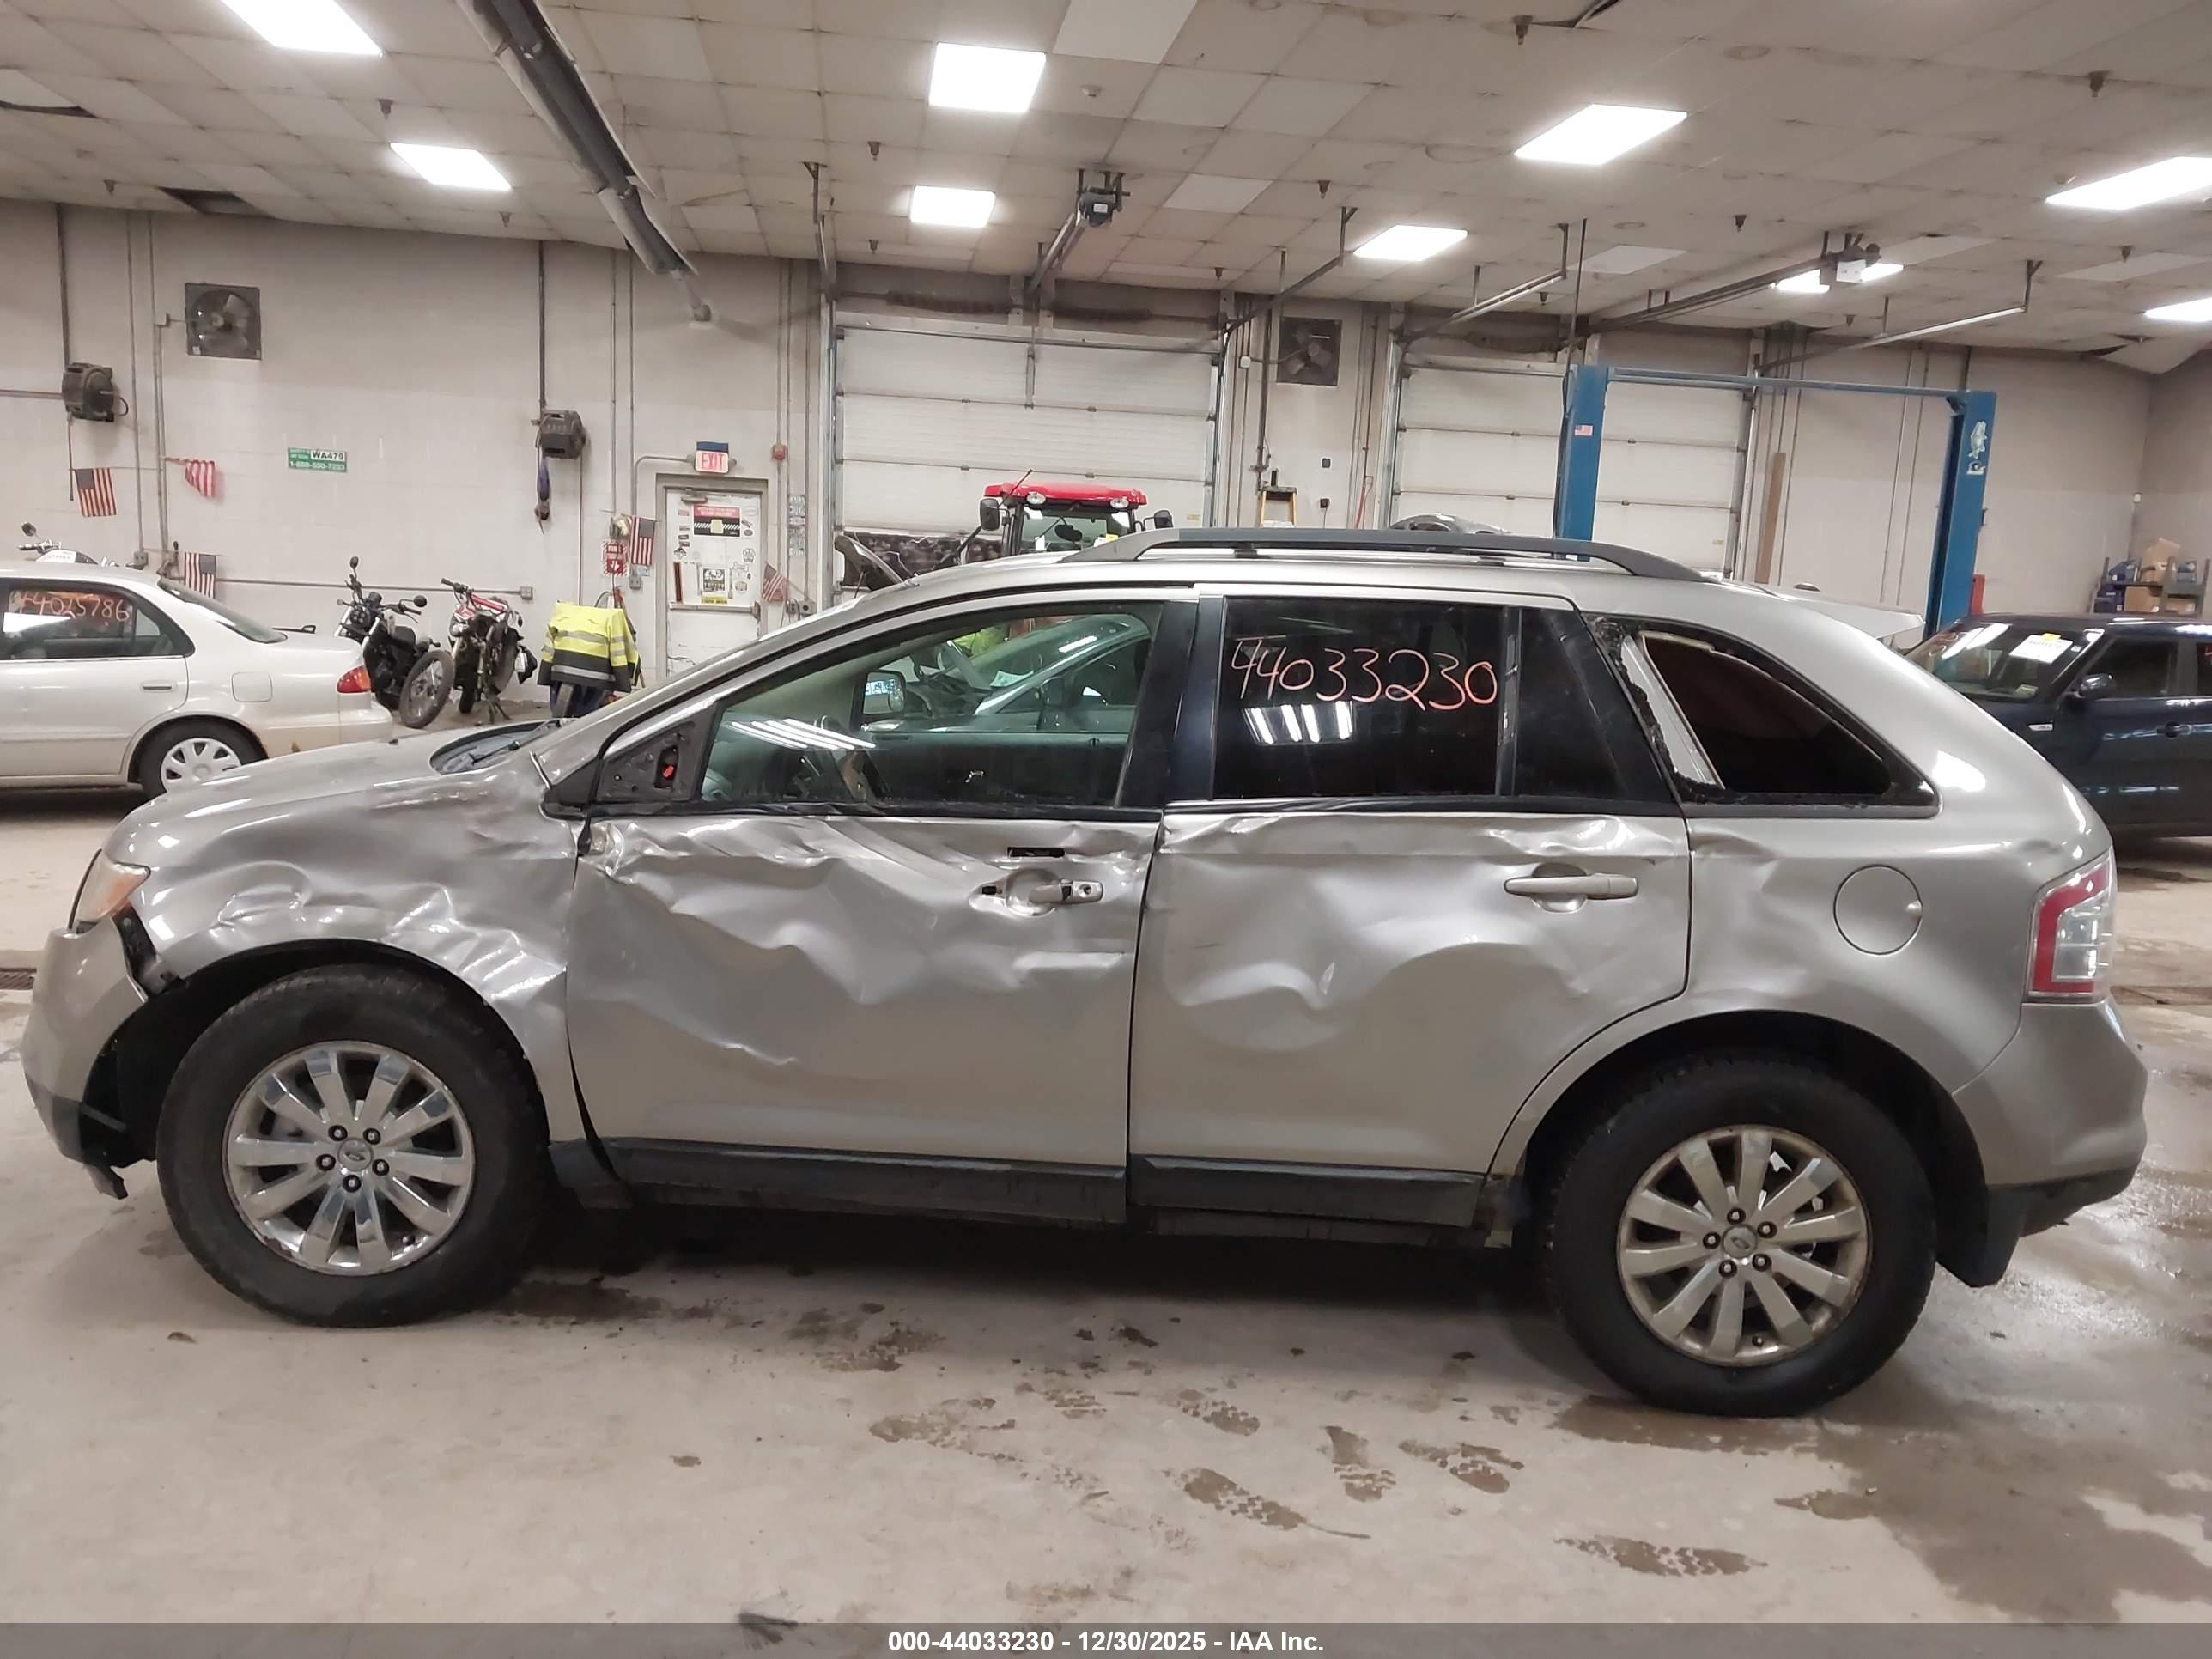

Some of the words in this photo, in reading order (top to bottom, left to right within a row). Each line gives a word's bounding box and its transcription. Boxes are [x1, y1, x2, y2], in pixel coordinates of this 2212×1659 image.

[312, 451, 344, 460] WA479
[701, 453, 725, 471] EXIT
[1230, 636, 1498, 712] 44033230
